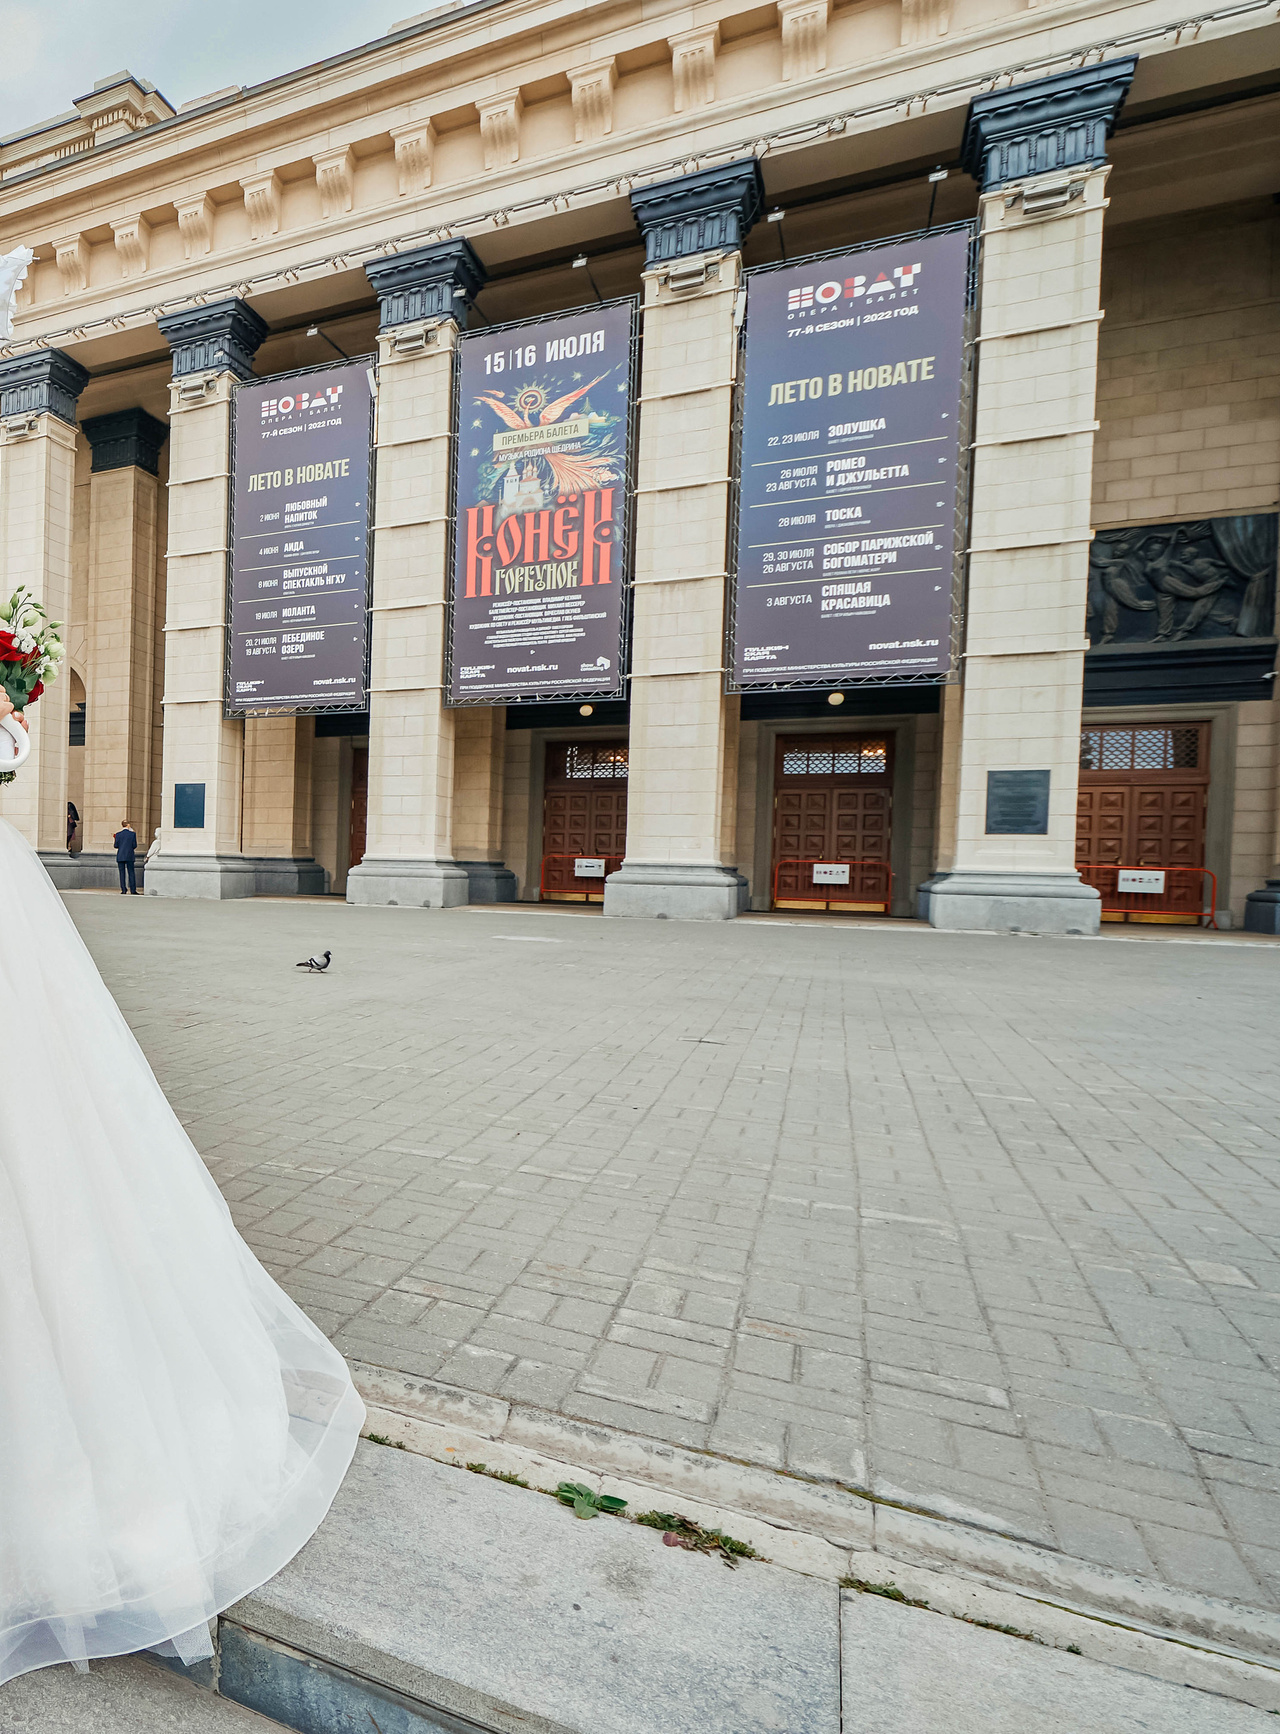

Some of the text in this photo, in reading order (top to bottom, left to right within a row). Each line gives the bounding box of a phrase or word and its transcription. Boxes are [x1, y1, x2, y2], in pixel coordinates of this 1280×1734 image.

[787, 288, 919, 320] ОПЕРА БАЛЕТ
[787, 305, 919, 338] 77-Й СЕЗОН 2022 ГОД
[546, 330, 605, 363] ИЮЛЯ
[768, 356, 936, 406] ЛЕТО В НОВАТЕ
[261, 405, 342, 425] ОПЕРА БАЛЕТ
[261, 418, 342, 439] 77-Й СЕЗОН 2022 ГОД
[502, 424, 579, 446] ПРЕМЬЕРА БАЛЕТА
[828, 418, 886, 437] ЗОЛУШКА
[782, 434, 793, 444] 23
[794, 430, 820, 442] ИЮЛЯ
[498, 452, 524, 462] МУЗЫКА
[524, 447, 551, 458] РОДИОНА
[781, 465, 818, 479] 26 ИЮЛЯ
[826, 456, 866, 473] РОМЕО
[248, 458, 350, 492] ЛЕТО В НОВАТЕ
[826, 464, 909, 487] И ДЖУЛЬЕТТА
[766, 482, 777, 492] 23
[778, 477, 817, 490] АВГУСТА
[285, 496, 328, 512] ЛЮБОВНЫЙ
[260, 514, 264, 522] 2
[284, 510, 318, 524] НАПИТОК
[778, 517, 789, 527] 28
[790, 514, 816, 526] ИЮЛЯ
[825, 506, 862, 522] ТОСКА
[284, 541, 304, 552] АИДА
[464, 488, 616, 598] КОНЁК
[823, 531, 934, 556] СОБОР ПАРИЖСКОЙ
[777, 551, 788, 560] 30
[789, 548, 814, 559] ИЮЛЯ
[823, 551, 897, 570] БОГОМАТЕРИ
[283, 563, 328, 579] ВЫПУСКНОЙ
[763, 564, 774, 574] 26
[775, 560, 814, 572] АВГУСТА
[283, 574, 346, 590] СПЕКТАКЛЬ НГХУ
[494, 560, 578, 596] ГОРБУНОК
[822, 582, 871, 597] СПЯЩАЯ
[767, 594, 812, 607] 3 АВГУСТА
[821, 594, 891, 611] КРАСАВИЦА
[282, 605, 316, 618] ИОЛАНТА
[254, 638, 260, 646] 21
[282, 630, 325, 644] ЛЕБЕДИНОЕ
[868, 639, 939, 650] novat.nsk.ru
[252, 646, 276, 655] АВГУСТА
[281, 644, 304, 654] ОЗЕРО
[506, 664, 558, 674] novat.nsk.ru
[313, 677, 356, 686] novat.nsk.ru
